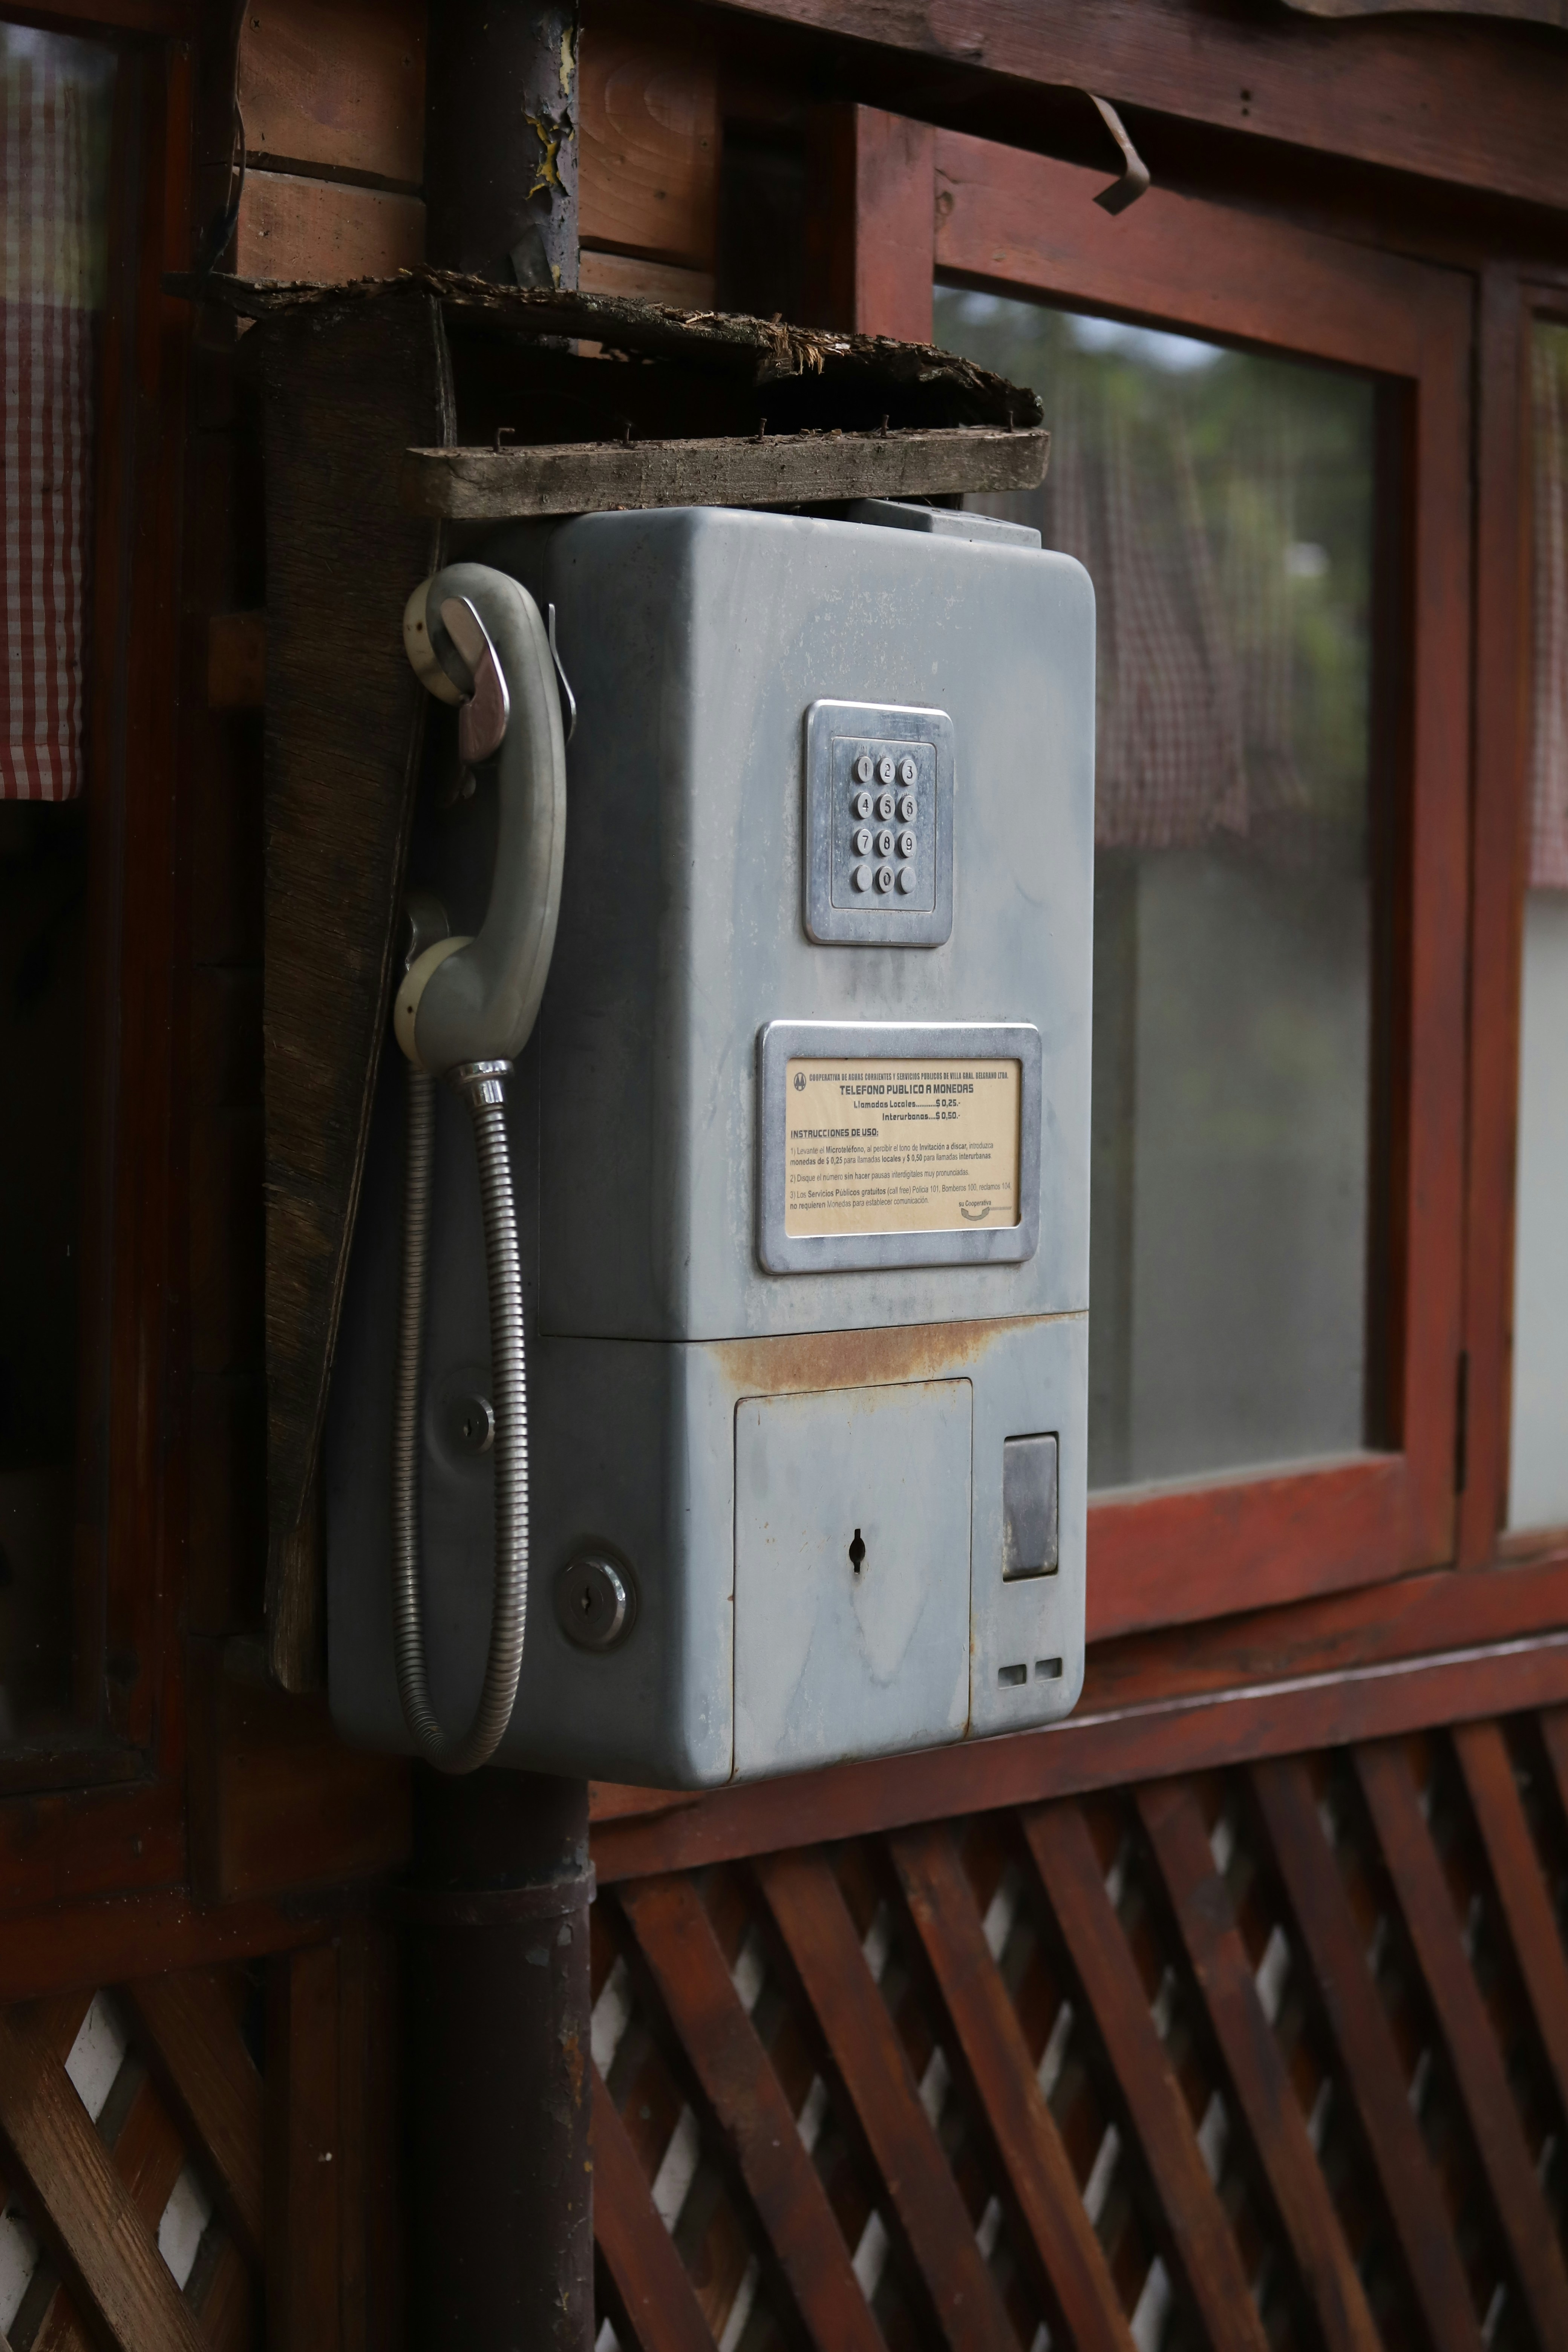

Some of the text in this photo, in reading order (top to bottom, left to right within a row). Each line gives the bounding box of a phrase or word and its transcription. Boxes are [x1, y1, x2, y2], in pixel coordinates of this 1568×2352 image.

[885, 763, 891, 778] 2
[906, 766, 913, 779] 3
[862, 799, 913, 817] 4 5 6
[862, 835, 912, 850] 7 8 9
[884, 873, 891, 886] 0
[840, 1084, 974, 1095] TELEFONO PUBLICO A MONEDAS
[854, 1100, 888, 1109] Llamadas
[790, 1129, 849, 1138] INSTRUCCIONES
[791, 1147, 795, 1156] 1)
[797, 1147, 818, 1155] Levante
[826, 1145, 865, 1154] Microteléfono,
[873, 1144, 892, 1153] percibir
[831, 1156, 842, 1165] 0,25
[912, 1154, 922, 1162] 0,50
[790, 1174, 795, 1184] 2)
[797, 1174, 815, 1183] Disque
[871, 1171, 890, 1181] pausas
[892, 1170, 923, 1179] interdigitales
[936, 1168, 969, 1178] pronunciadas.
[790, 1191, 795, 1200] 3)
[862, 1188, 886, 1197] gratuitos
[887, 1187, 898, 1196] (call
[899, 1186, 911, 1195] free)
[799, 1202, 825, 1210] requieren
[894, 1196, 929, 1205] comunicación.
